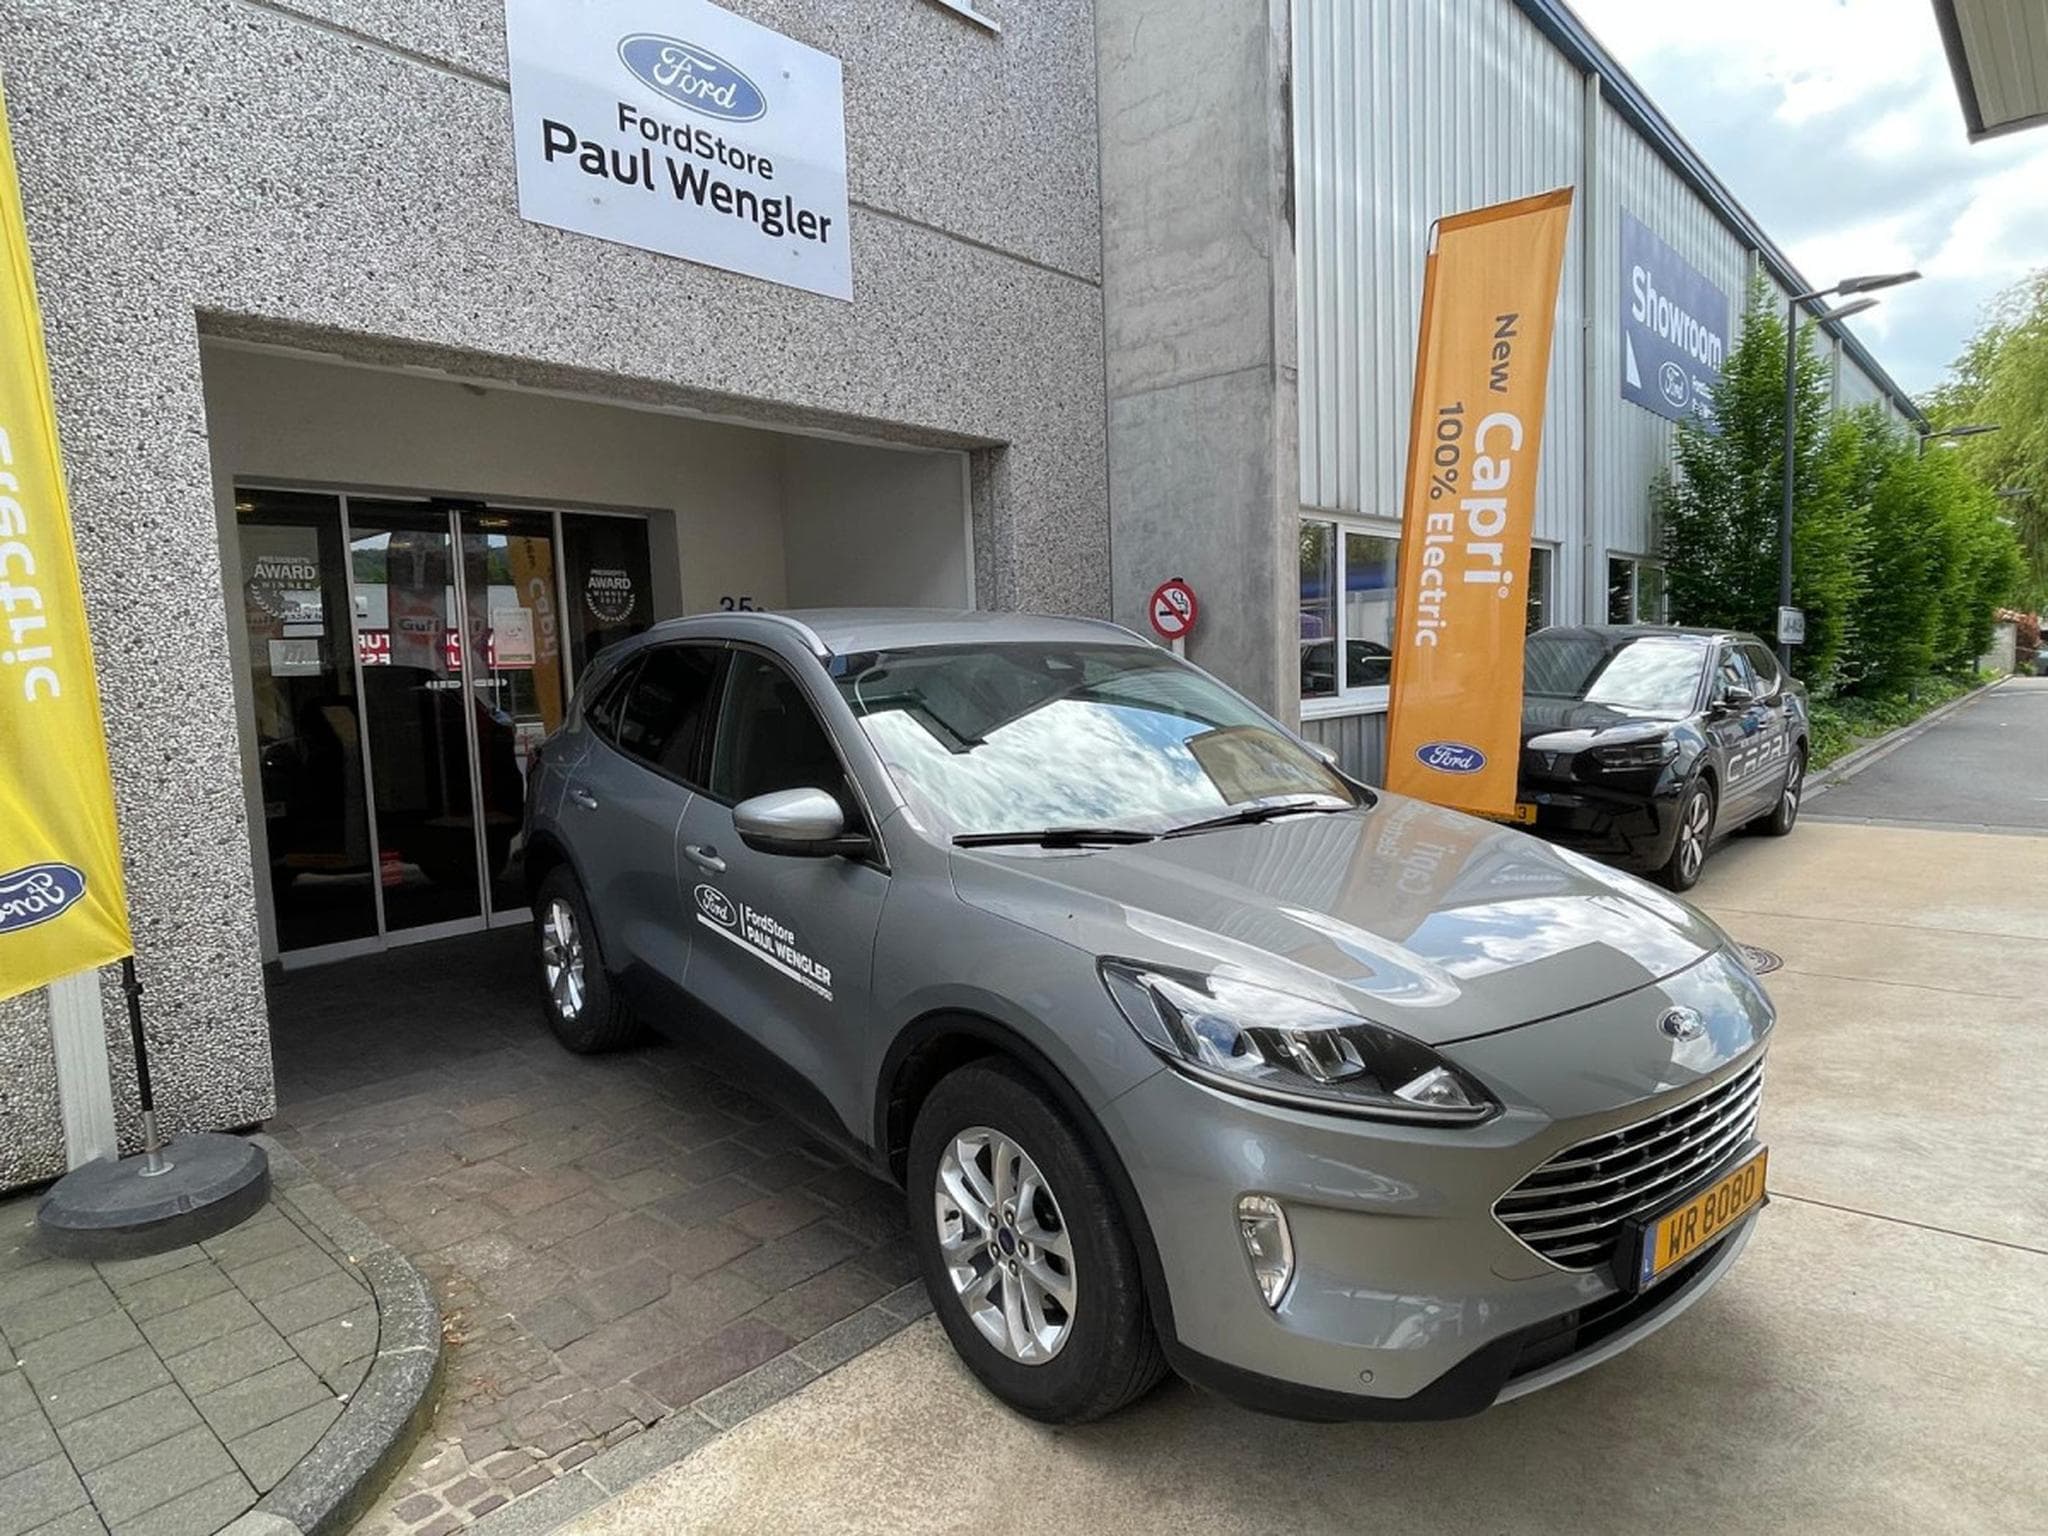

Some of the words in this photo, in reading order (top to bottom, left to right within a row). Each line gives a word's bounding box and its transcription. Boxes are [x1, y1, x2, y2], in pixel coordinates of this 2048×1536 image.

[653, 47, 737, 111] Ford
[617, 102, 774, 180] FordStore
[542, 118, 655, 191] Paul
[666, 156, 832, 243] Wengler
[1489, 313, 1519, 393] New
[1631, 265, 1723, 373] Showroom
[1430, 402, 1464, 500] 100%
[1460, 412, 1524, 584] Capri
[254, 563, 316, 580] AWARD
[588, 576, 632, 590] AWARD
[720, 596, 766, 612] 35
[1415, 512, 1455, 647] Electric
[1429, 745, 1474, 770] Ford
[702, 888, 728, 921] Ford
[745, 906, 795, 945] FordStore
[747, 926, 776, 954] PAUL
[774, 940, 832, 986] WENGLER
[1669, 1205, 1699, 1259] WR
[1702, 1164, 1756, 1235] 8080
